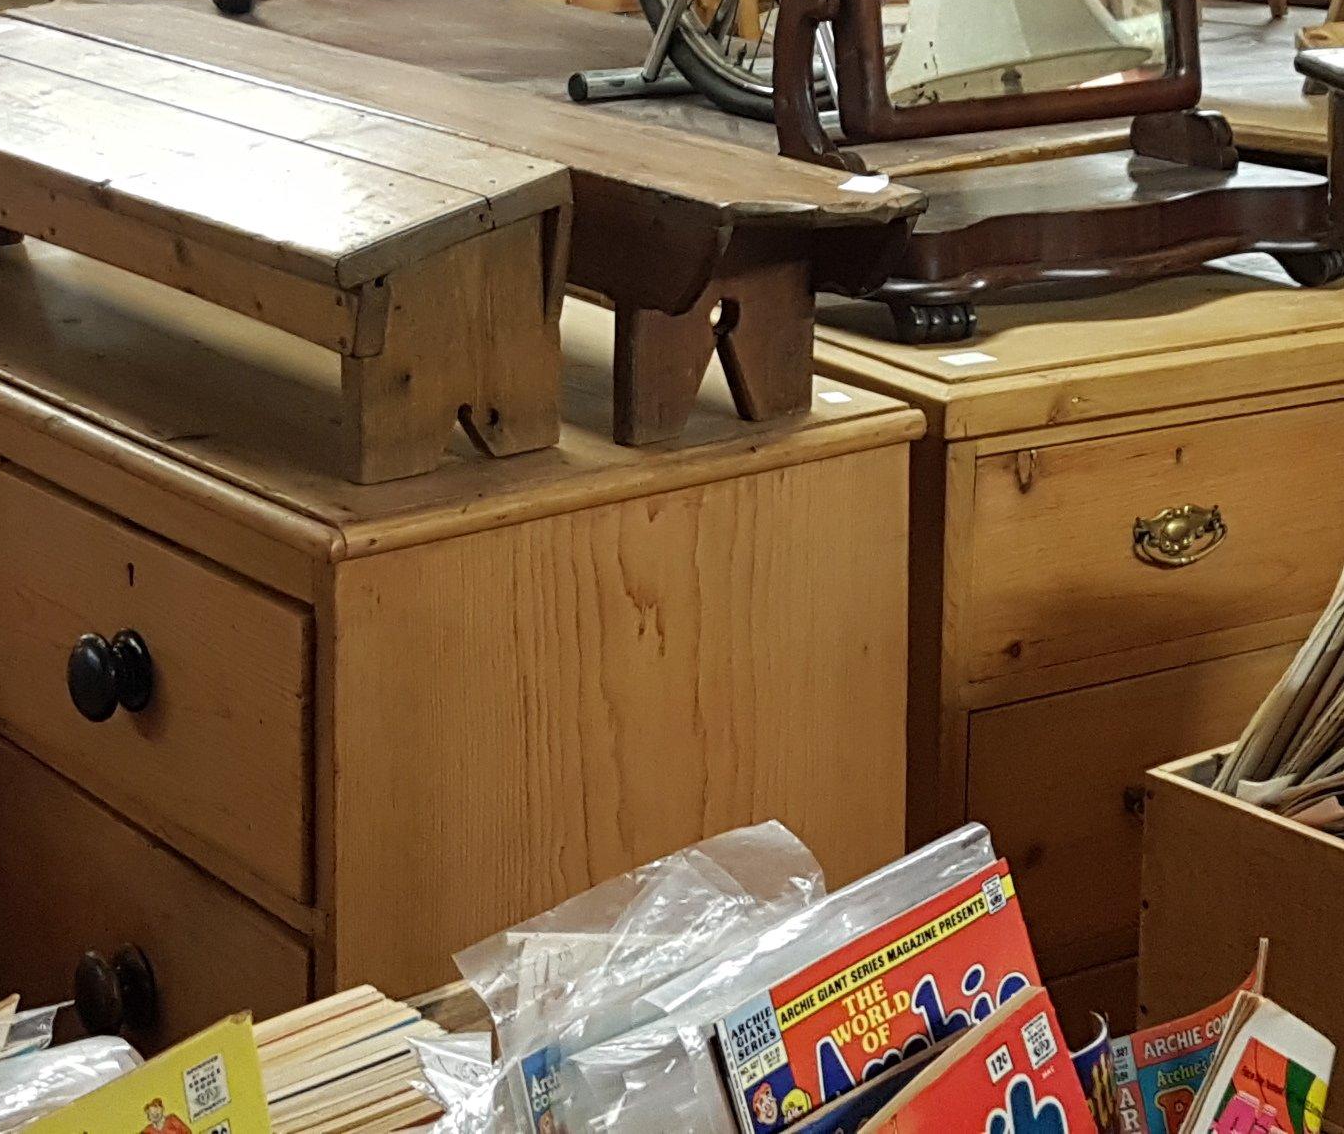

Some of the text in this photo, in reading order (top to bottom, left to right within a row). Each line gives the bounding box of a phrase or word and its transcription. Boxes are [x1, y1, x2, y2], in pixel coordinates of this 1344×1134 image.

[780, 897, 985, 1026] ARCHIE GIANT SERIES MAGAZINE PRESENTS
[842, 978, 888, 1017] THE
[731, 1005, 772, 1040] ARCHIE
[736, 1019, 771, 1048] GIANT
[831, 990, 911, 1048] WORLD
[737, 1028, 777, 1061] SERIES
[862, 1023, 892, 1054] OF
[1144, 1026, 1203, 1059] ARCHIE
